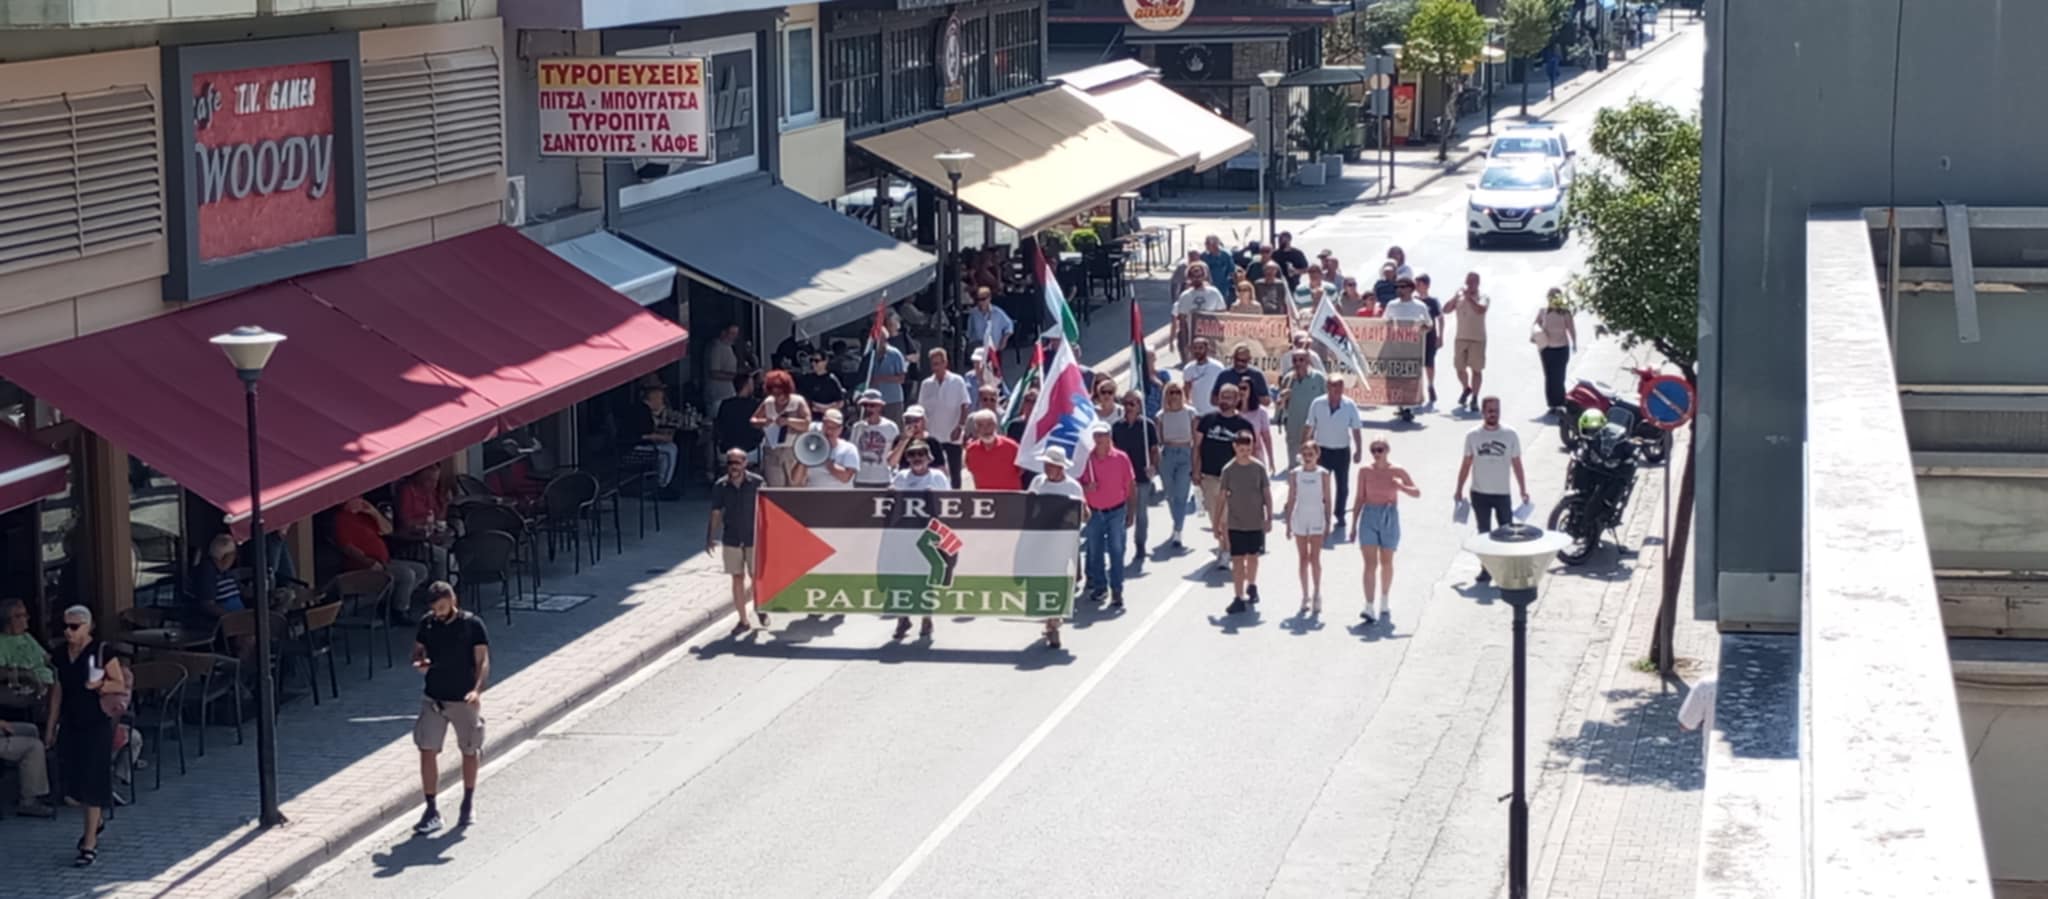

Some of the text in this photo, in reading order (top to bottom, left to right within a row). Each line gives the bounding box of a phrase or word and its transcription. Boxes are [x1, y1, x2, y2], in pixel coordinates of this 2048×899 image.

[541, 64, 699, 86] ΤΥΡΟΓΕΥΣΕΙΣ
[234, 82, 261, 115] T.V.
[266, 77, 316, 111] GAMES
[540, 92, 699, 110] ΠΙΤΣΑ ΜΠΟΥΓΑΤΣΑ
[568, 113, 671, 131] ΤΥΡΟΠΙΤΑ
[543, 134, 636, 153] ΣΑΝΤΟΥΙΤΣ
[652, 134, 698, 153] ΚΑΦΕ
[195, 134, 333, 206] WOODY
[872, 497, 997, 519] FREE
[803, 588, 1063, 612] PALESTINE
